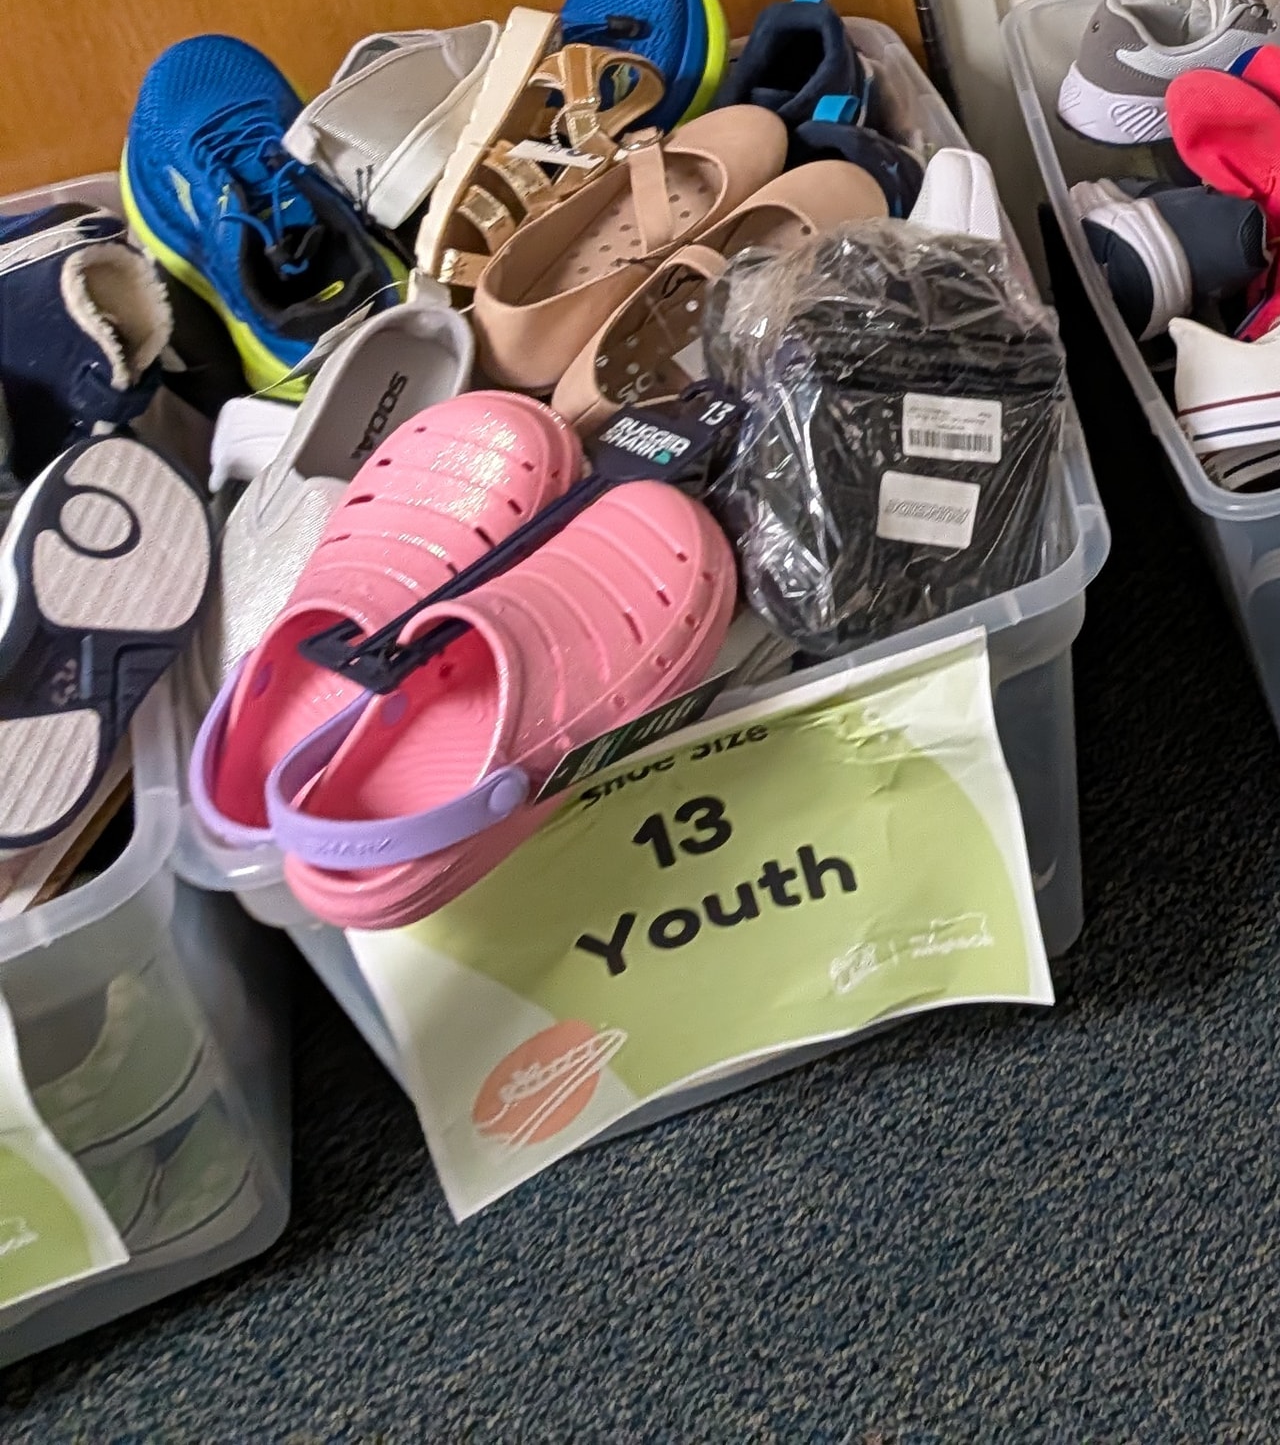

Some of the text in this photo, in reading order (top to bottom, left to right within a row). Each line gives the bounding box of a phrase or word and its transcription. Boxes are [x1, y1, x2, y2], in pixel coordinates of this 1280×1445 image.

[698, 400, 737, 426] 13
[632, 796, 732, 869] 13
[576, 845, 857, 976] Youth
